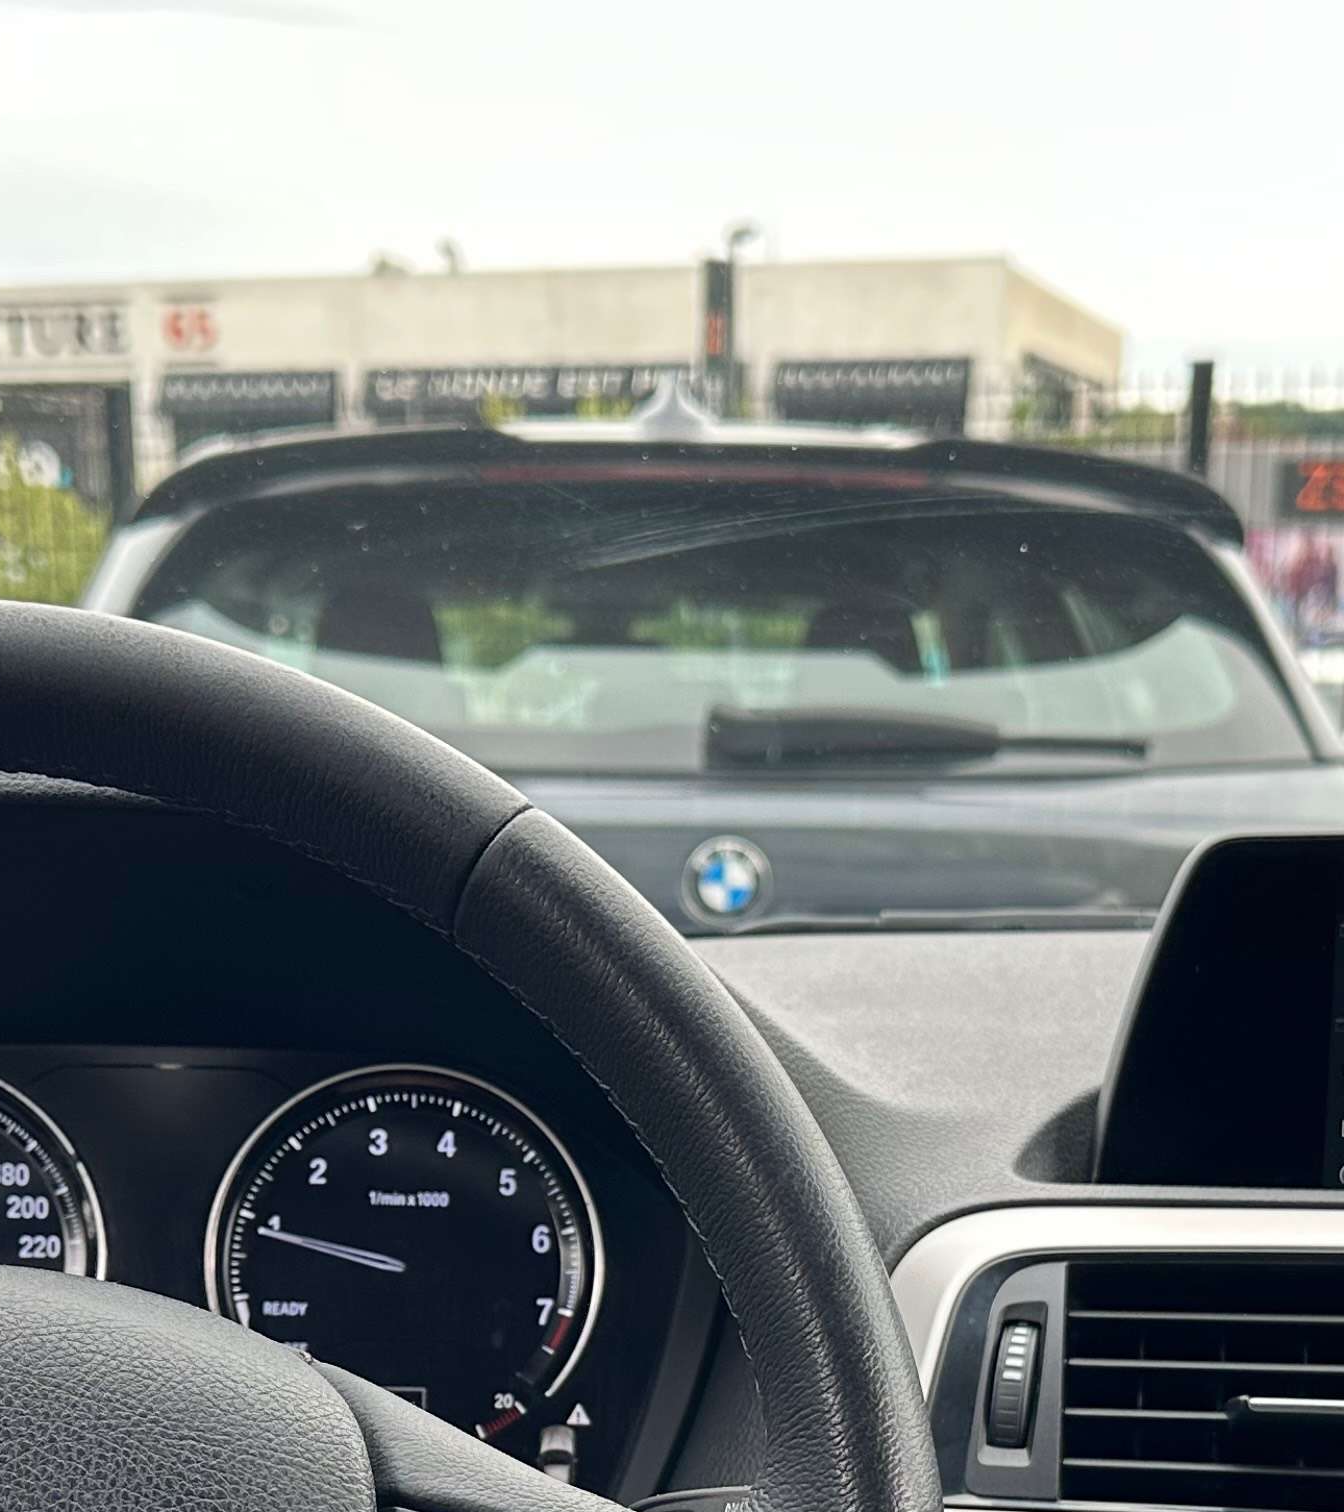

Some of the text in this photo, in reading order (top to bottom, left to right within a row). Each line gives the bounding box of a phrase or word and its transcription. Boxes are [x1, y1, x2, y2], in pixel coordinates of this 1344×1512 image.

[368, 1129, 389, 1156] 3
[436, 1130, 457, 1158] 4
[308, 1159, 328, 1186] 2
[499, 1169, 518, 1196] 5
[6, 1196, 49, 1220] 200
[18, 1235, 61, 1259] 220
[531, 1225, 551, 1254] 6
[262, 1301, 308, 1316] READY
[536, 1298, 555, 1326] 7
[494, 1394, 514, 1409] 20
